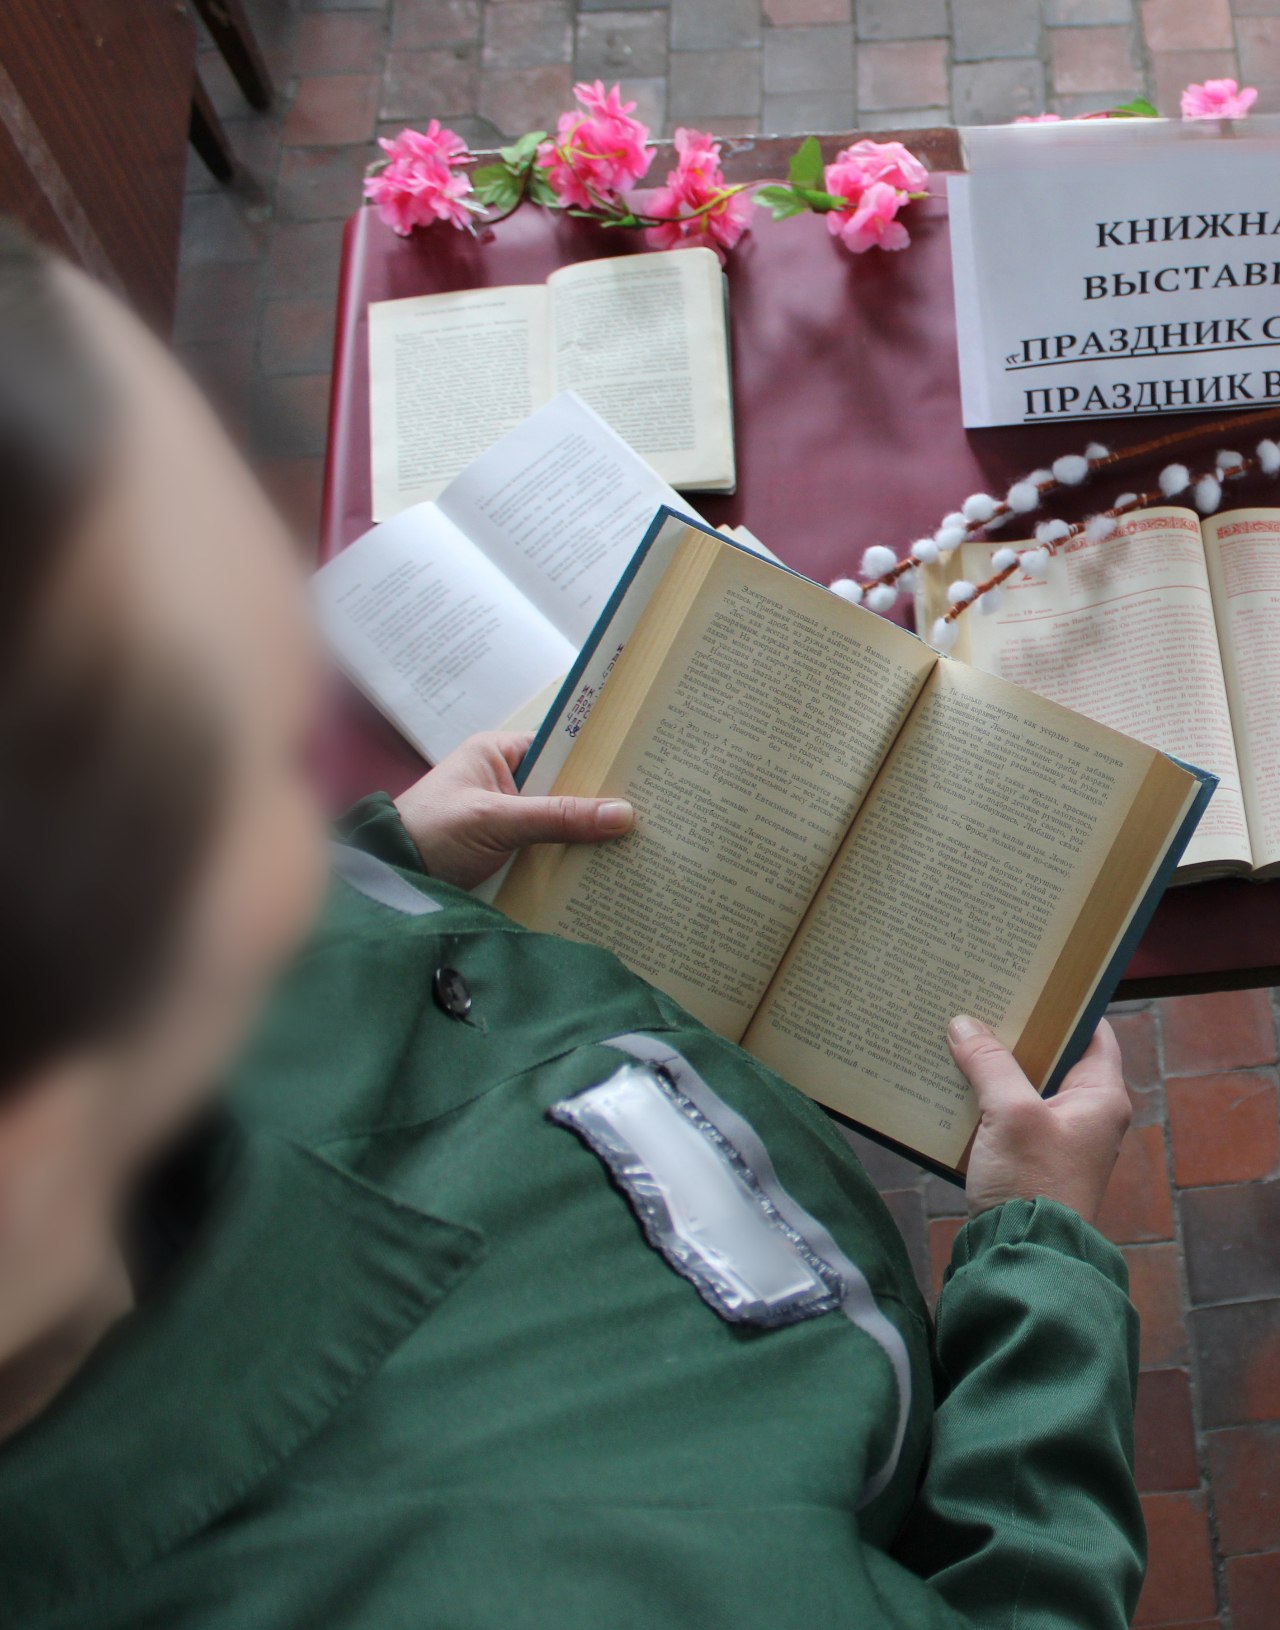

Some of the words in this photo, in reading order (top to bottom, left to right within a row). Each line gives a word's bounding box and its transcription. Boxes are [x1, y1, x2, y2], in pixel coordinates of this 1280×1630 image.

[1006, 317, 1252, 366] «ПРАЗДНИК
[1023, 372, 1253, 416] ПРАЗДНИК
[740, 584, 783, 610] Электричка
[785, 607, 819, 628] подошла
[821, 624, 829, 632] к
[830, 629, 862, 649] станции
[863, 644, 891, 665] Ямполь
[681, 699, 725, 724] Маленькая
[728, 722, 760, 743] Леночка
[767, 741, 781, 752] без
[786, 751, 814, 769] устали
[960, 692, 982, 705] только
[984, 702, 1019, 723] посмотри,
[1022, 718, 1038, 729] как
[1038, 725, 1070, 743] усердно
[1071, 740, 1090, 753] твоя
[1091, 749, 1124, 768] дочурка
[989, 721, 1021, 741] Леночка
[1024, 737, 1064, 760] выглядела
[1067, 756, 1081, 768] так
[1083, 764, 1119, 785] забавно,
